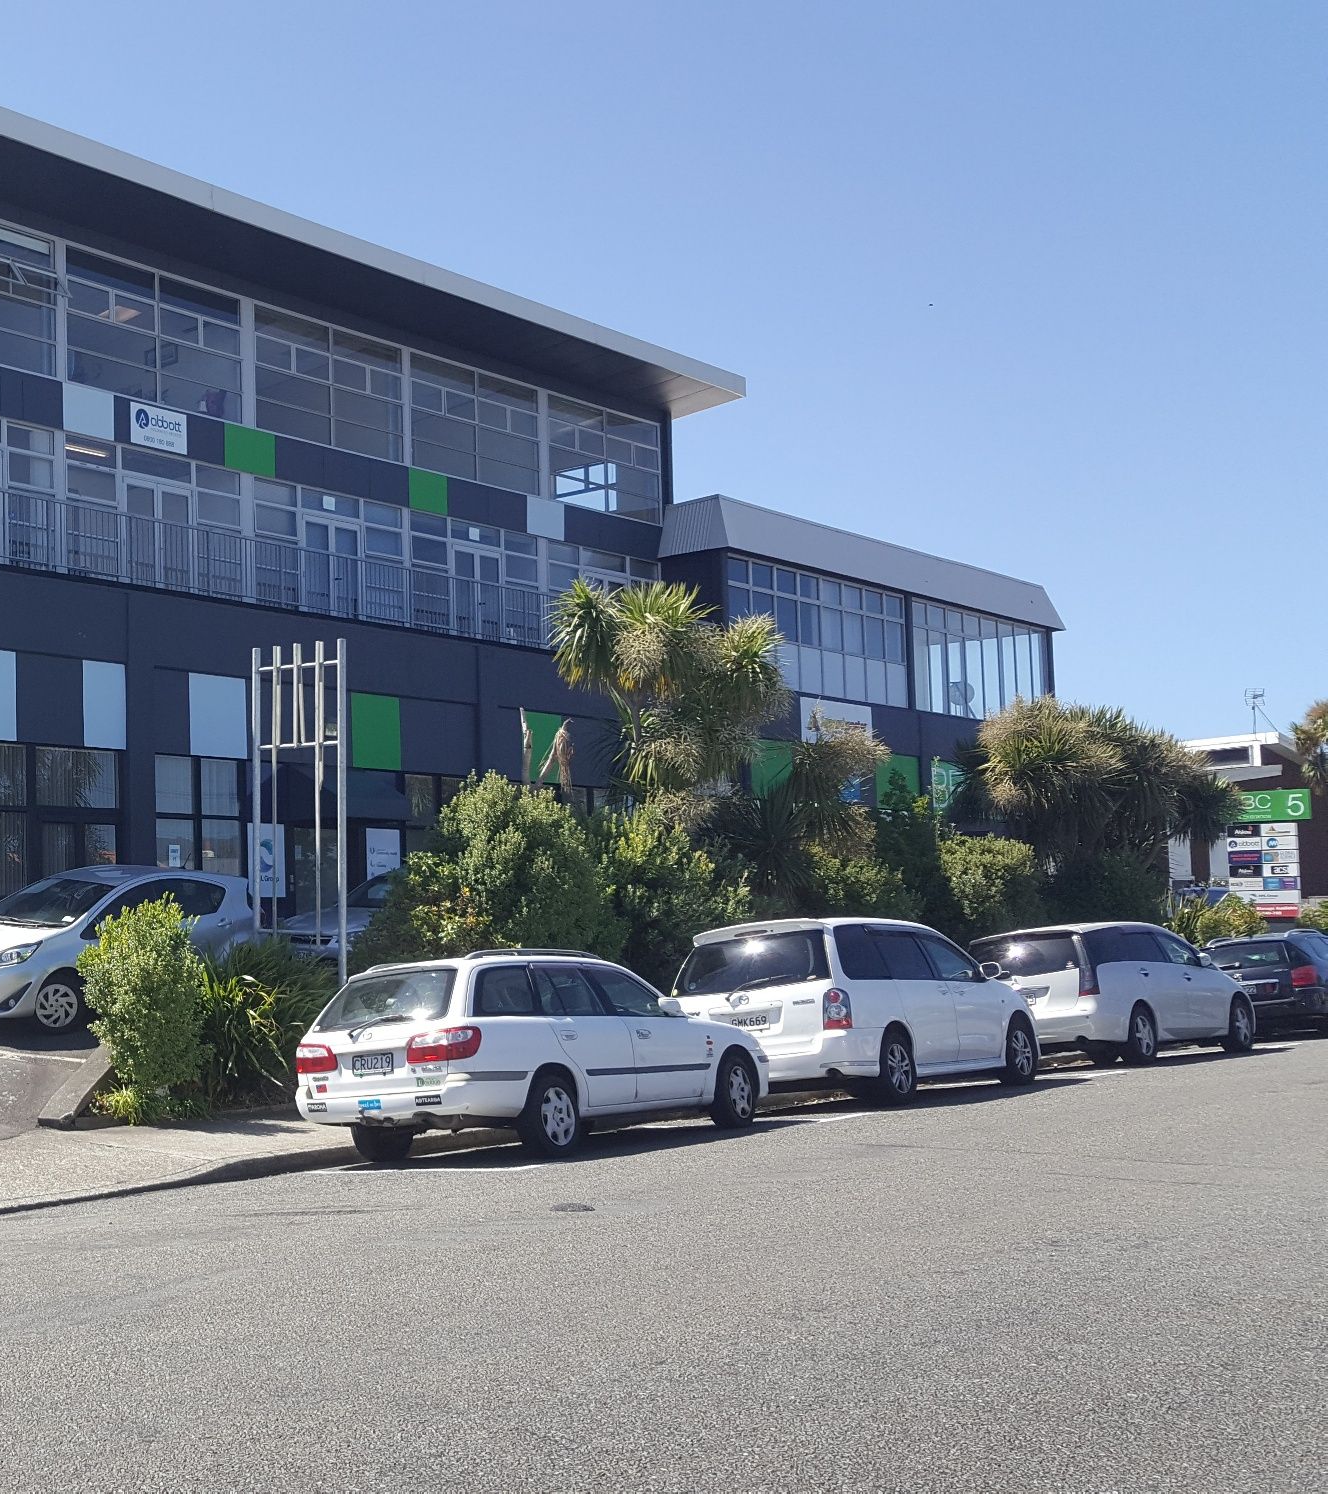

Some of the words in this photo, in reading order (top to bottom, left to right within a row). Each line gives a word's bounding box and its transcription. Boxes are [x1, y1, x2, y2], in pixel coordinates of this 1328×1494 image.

[151, 415, 182, 433] abbott
[1287, 794, 1304, 816] 5
[731, 1015, 767, 1028] GMK669
[354, 1055, 391, 1071] CRU219
